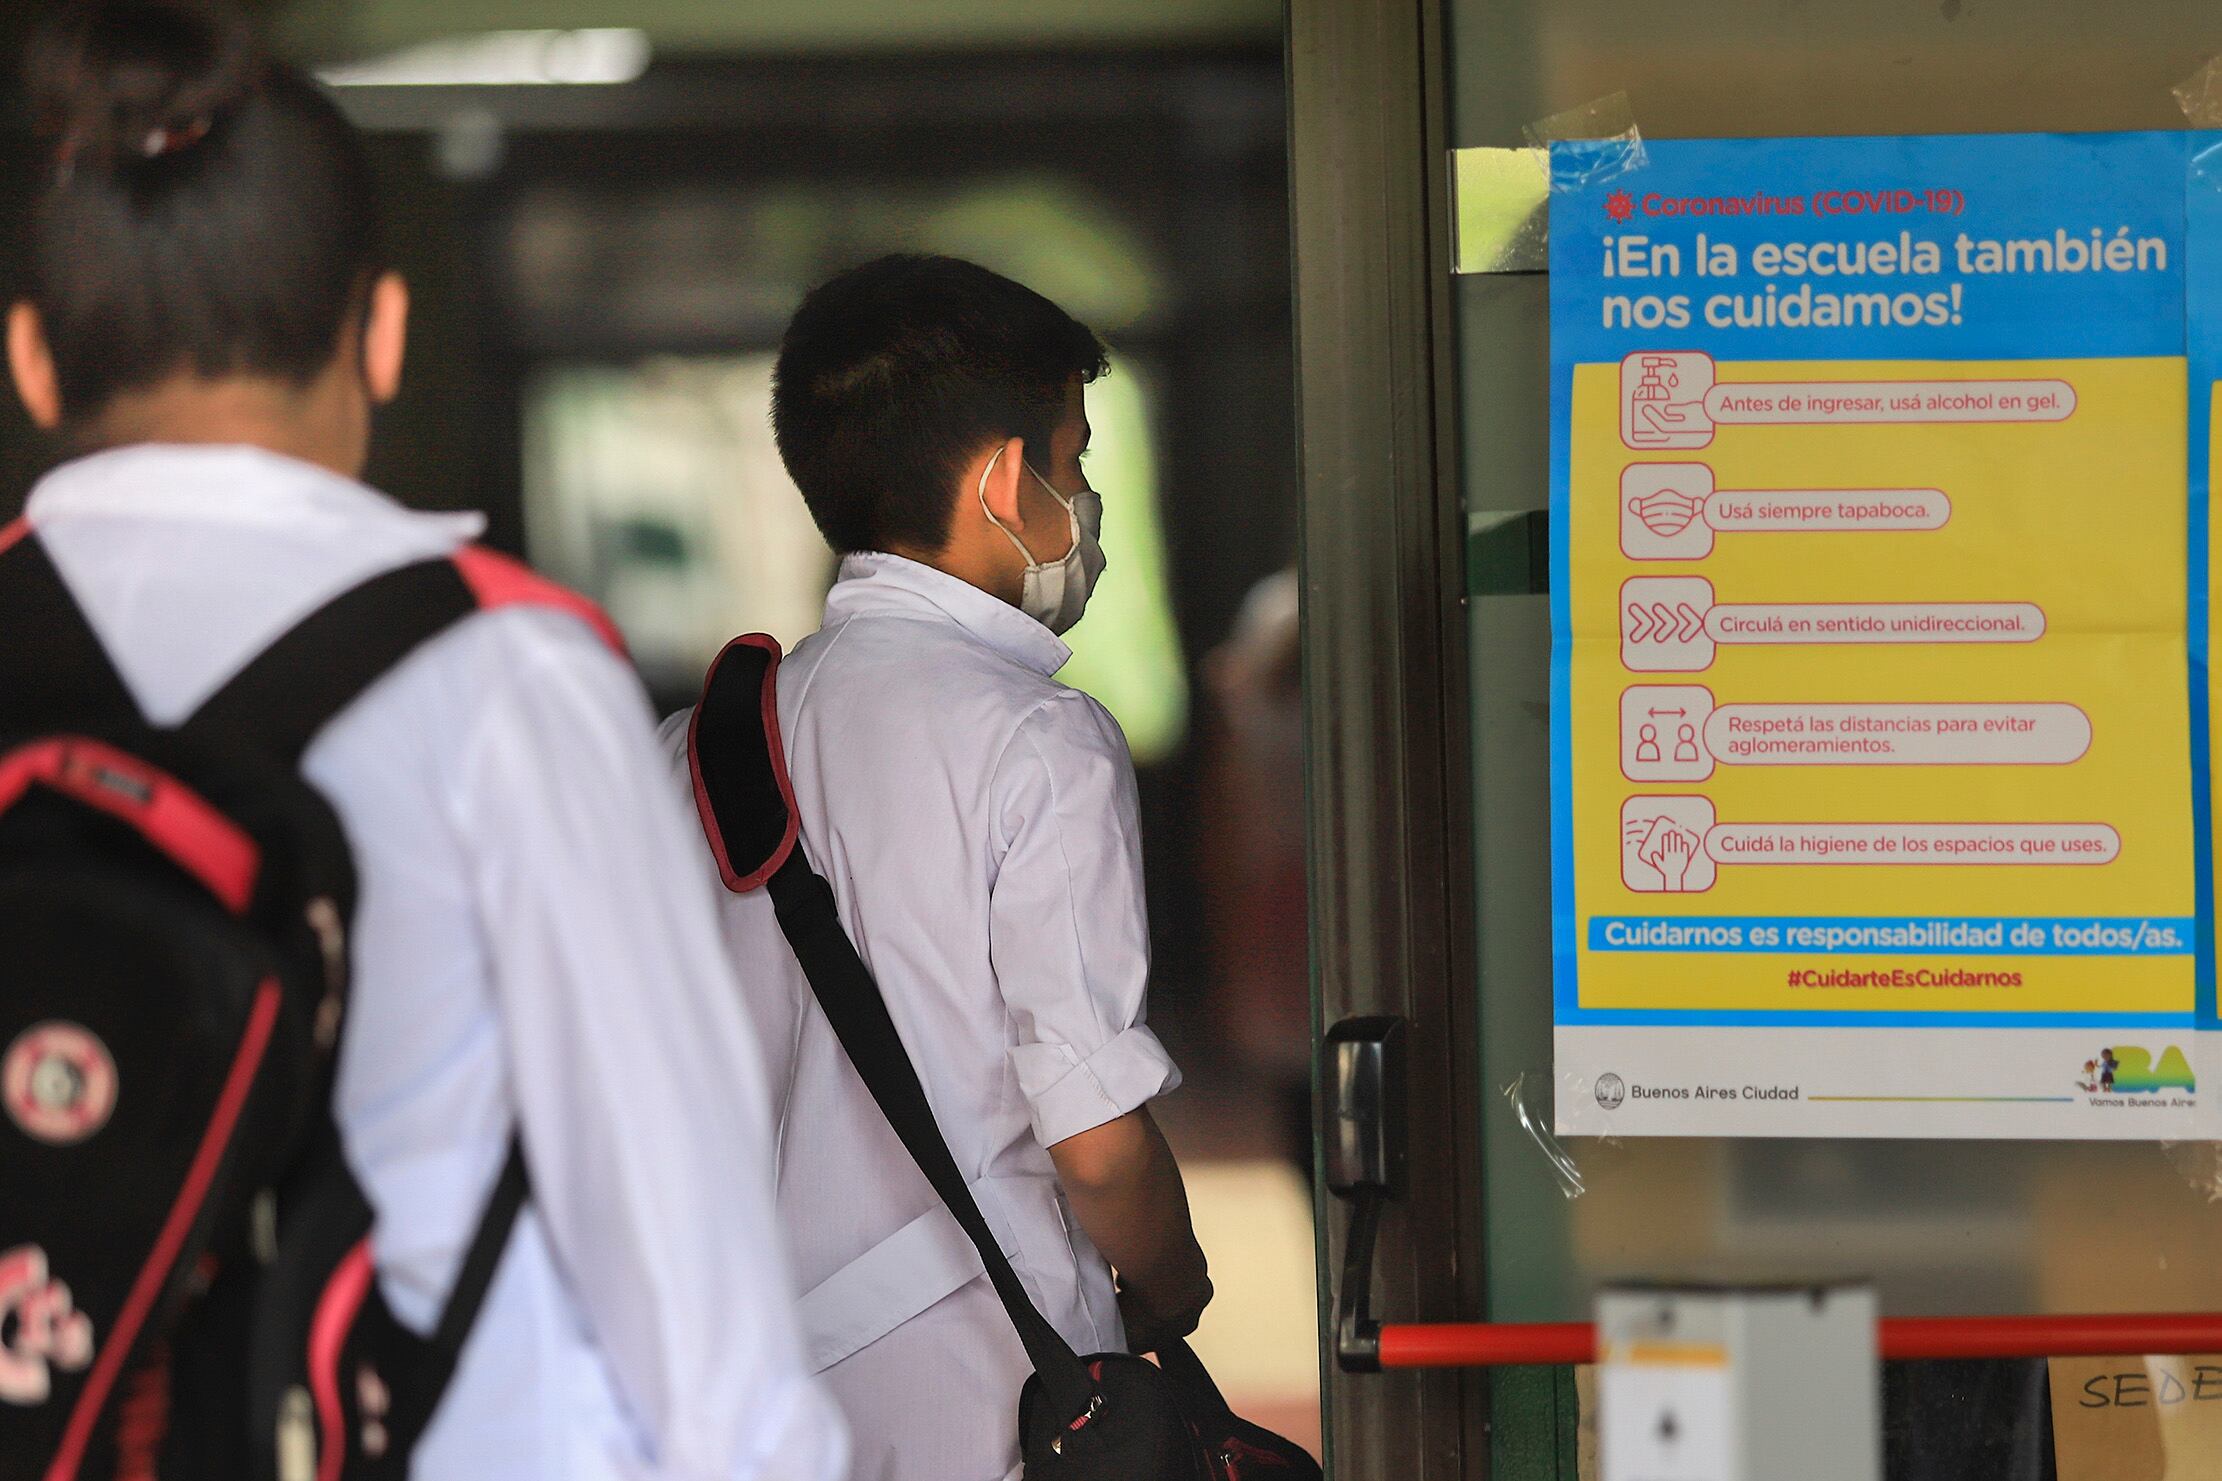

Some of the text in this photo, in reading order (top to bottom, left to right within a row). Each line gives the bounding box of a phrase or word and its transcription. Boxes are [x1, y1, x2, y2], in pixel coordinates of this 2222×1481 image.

[1642, 188, 1965, 217] Coronavirus (COVID-19)
[1603, 226, 2167, 277] ¡En la escuela también
[1603, 283, 1963, 329] nos cuidamos!
[1720, 393, 2060, 414] Antes de ingresar, usá alcohol en gel.
[1719, 502, 1930, 522] Usá siempre tapaboca.
[1720, 615, 2025, 633] Circulá en sentido unidireccional.
[1728, 715, 2035, 735] Respetá las distancias para evitar
[1728, 737, 1895, 756] aglomeramientos.
[1721, 835, 2107, 856] Cuidá la higiene de los espacios que uses.
[1605, 922, 2184, 950] Cuidarnos es responsabilidad de todos/as.
[1788, 968, 2023, 988] #CuidarteEsCuidarnos
[2111, 1044, 2195, 1094] BA
[1631, 1085, 1799, 1100] Buenos Aires Ciudad
[2089, 1097, 2125, 1107] Vamos
[2128, 1097, 2167, 1107] Buenos
